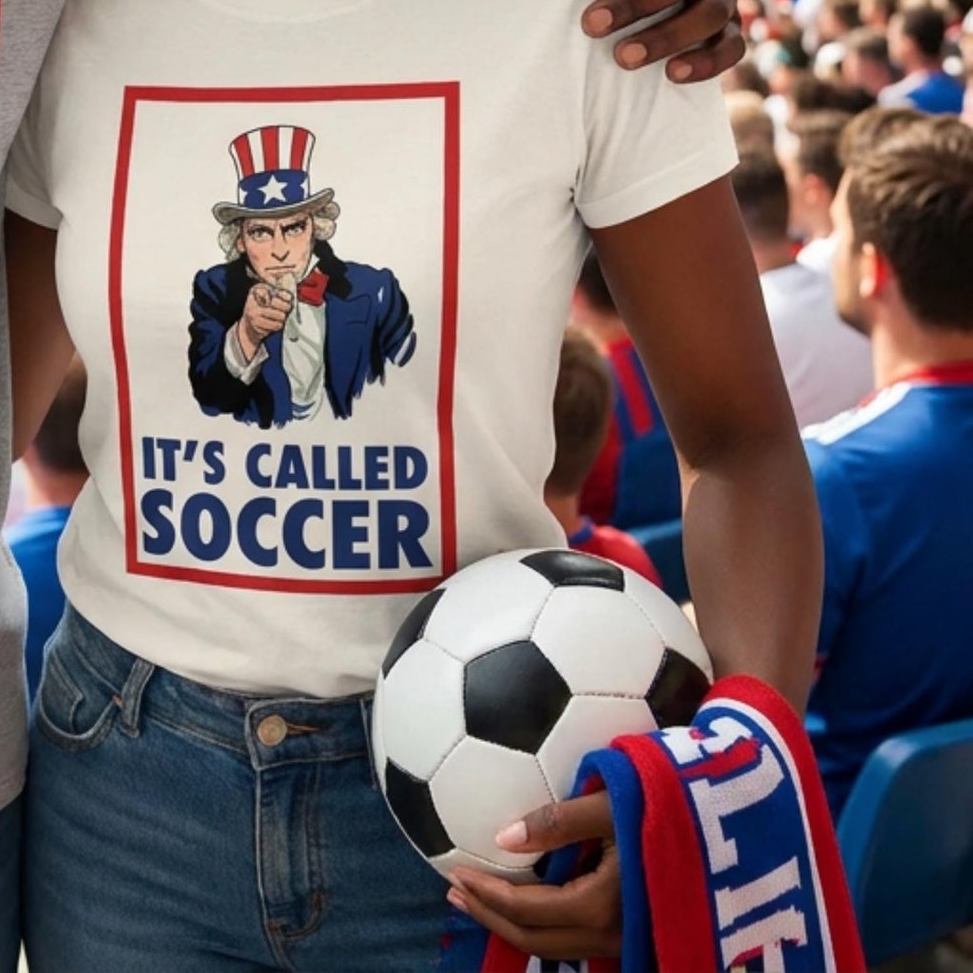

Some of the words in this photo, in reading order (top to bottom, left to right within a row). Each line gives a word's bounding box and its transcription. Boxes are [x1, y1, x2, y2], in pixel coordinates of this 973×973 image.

[141, 436, 226, 485] IT'S
[245, 442, 429, 491] CALLED
[140, 488, 434, 570] SOCCER
